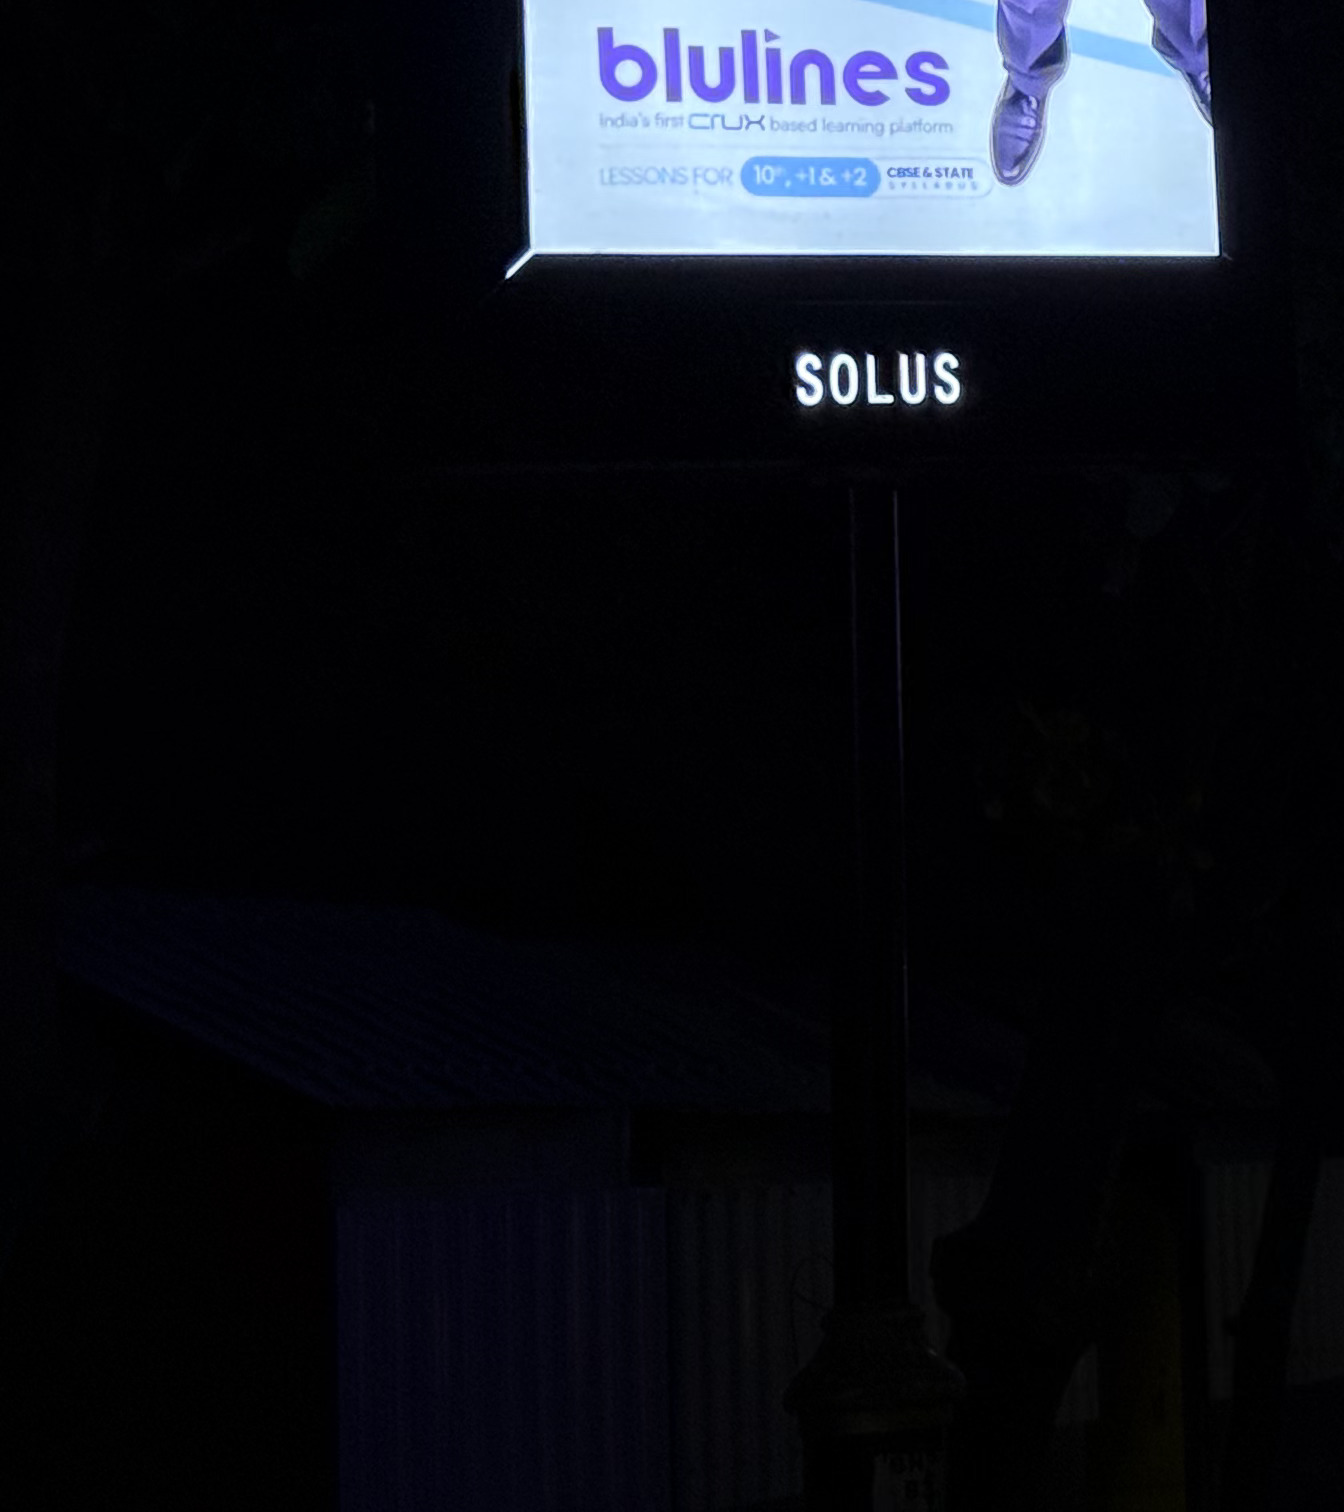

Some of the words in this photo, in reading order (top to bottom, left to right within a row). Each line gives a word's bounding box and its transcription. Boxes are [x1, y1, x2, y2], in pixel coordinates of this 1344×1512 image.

[597, 26, 950, 107] blulines
[599, 113, 650, 129] India's
[655, 113, 685, 128] first
[770, 116, 817, 133] based
[823, 116, 885, 137] learning
[890, 117, 953, 137] platform
[600, 166, 689, 186] LESSONS
[693, 166, 733, 186] FOR
[819, 168, 836, 186] &
[841, 168, 867, 186] +2
[887, 167, 921, 178] CBSE
[923, 167, 932, 178] &
[795, 352, 960, 407] SOLUS
